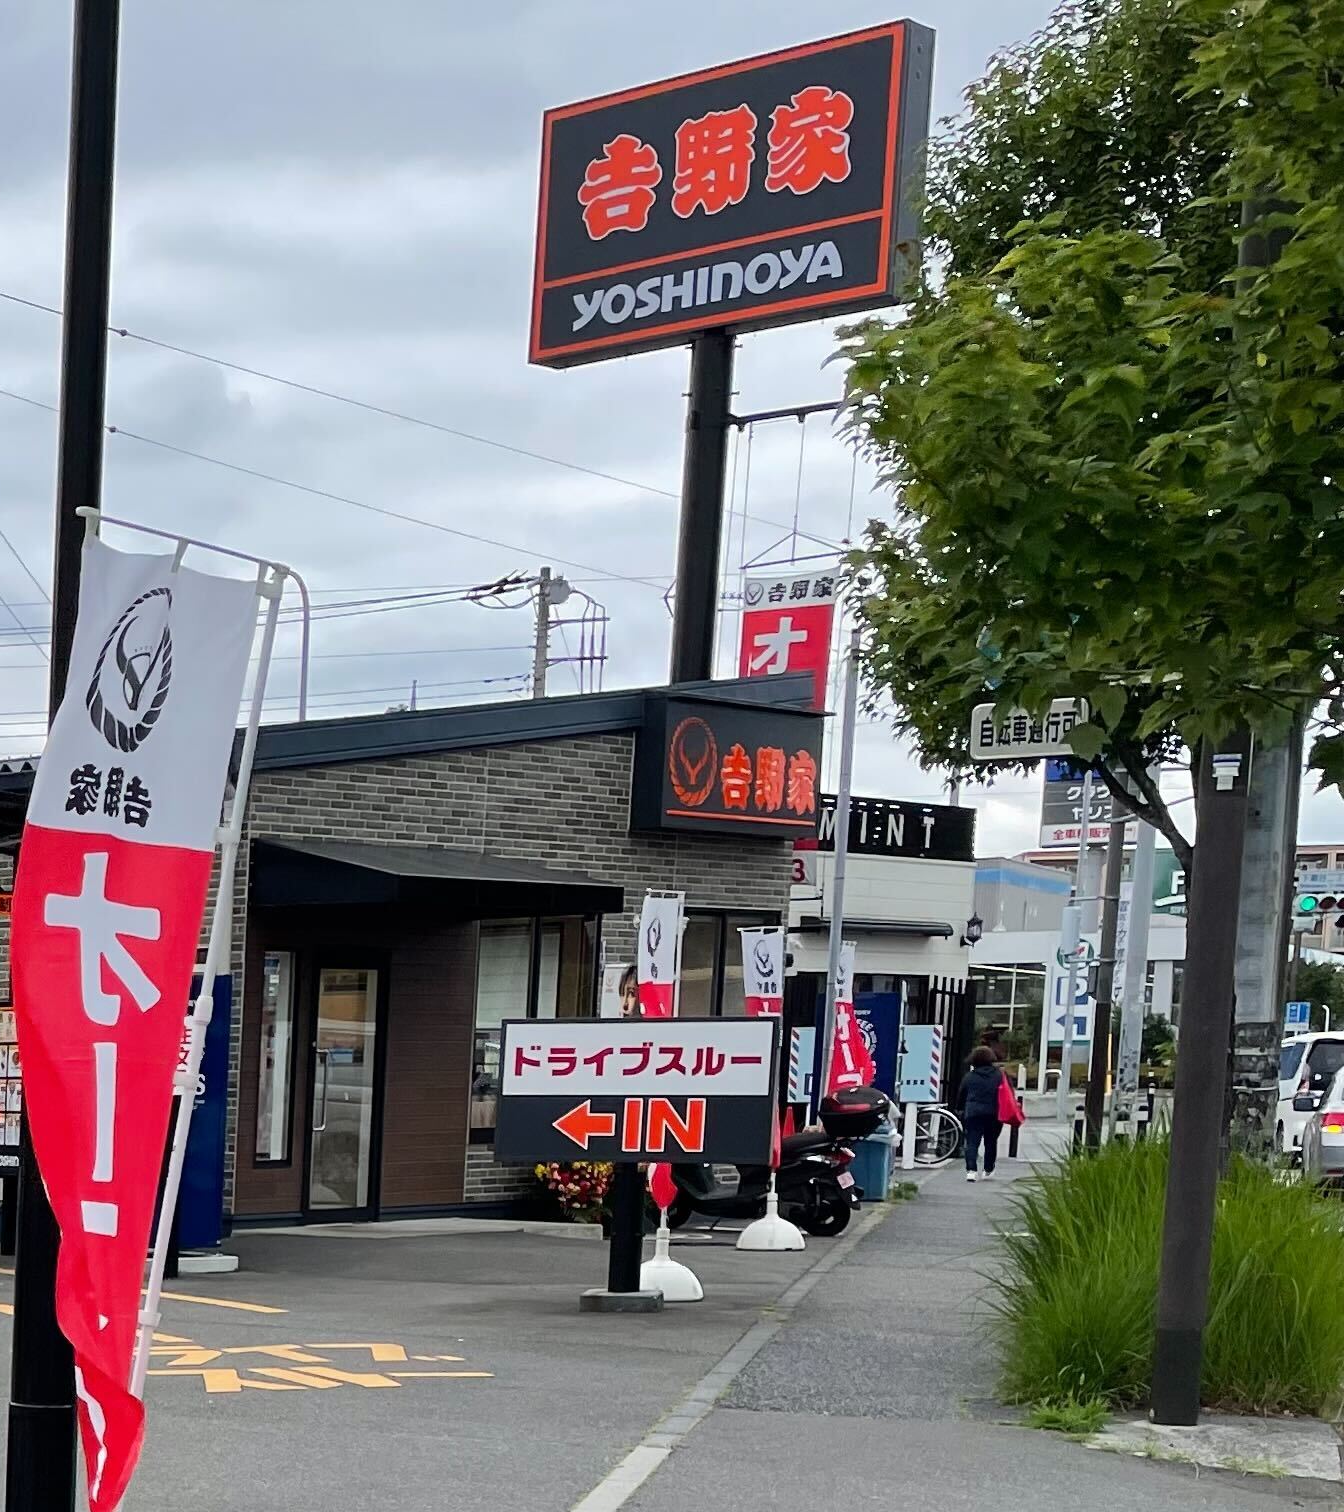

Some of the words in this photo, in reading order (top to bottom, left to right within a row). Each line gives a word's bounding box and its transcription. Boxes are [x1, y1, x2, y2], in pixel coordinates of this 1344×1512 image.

[571, 240, 844, 332] YOSHINOYA
[818, 808, 935, 849] MINT
[514, 1041, 763, 1077] ドライブスルー
[621, 1097, 706, 1153] IN
